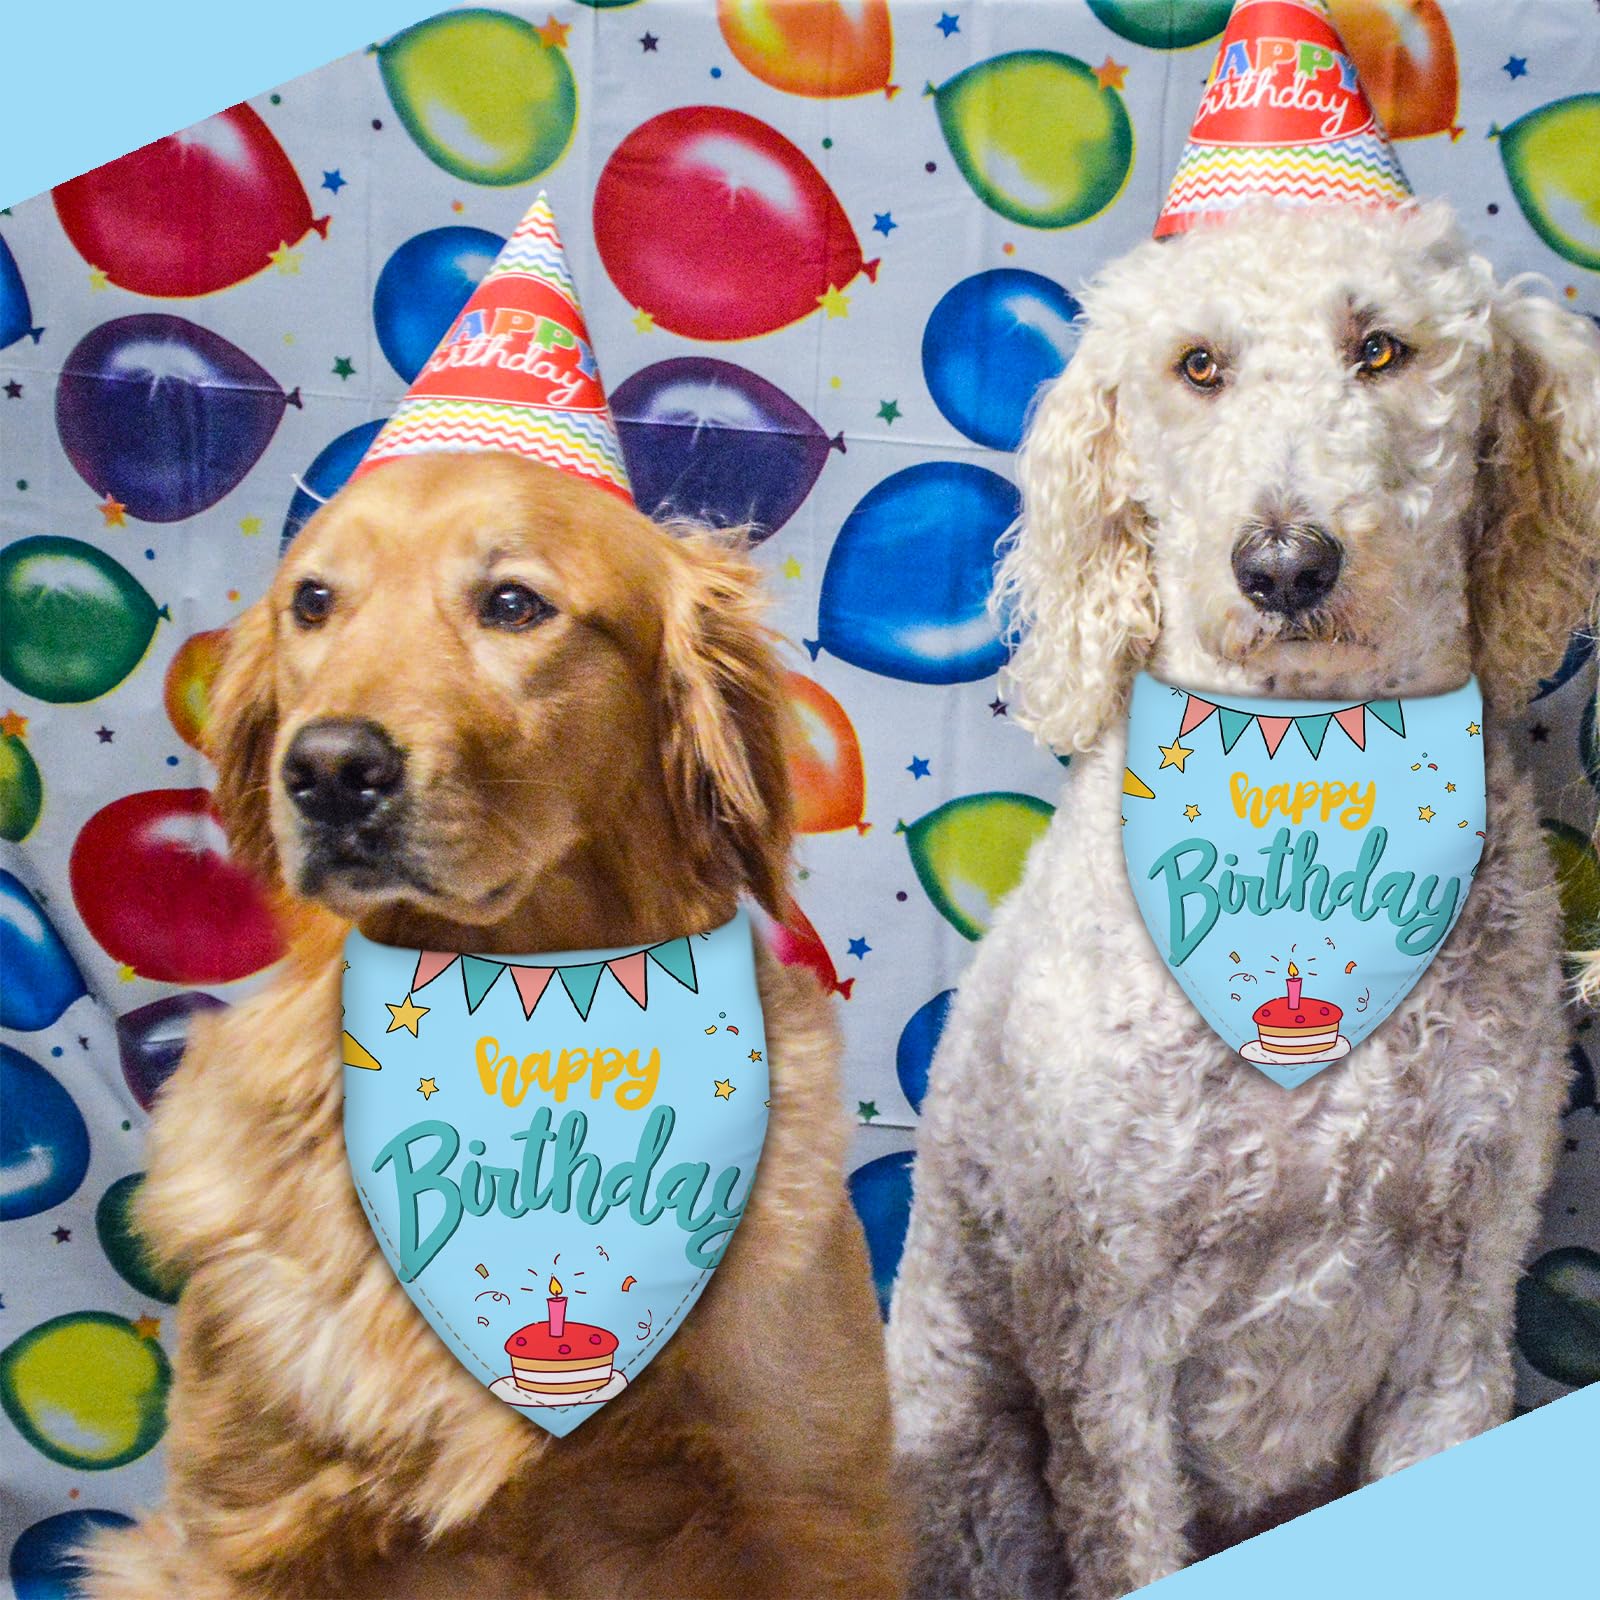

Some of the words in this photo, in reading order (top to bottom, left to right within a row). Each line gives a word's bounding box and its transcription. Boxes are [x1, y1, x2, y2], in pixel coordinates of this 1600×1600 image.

[1204, 37, 1359, 95] APPY
[416, 332, 584, 405] irthday
[1229, 771, 1376, 831] happy
[1148, 826, 1460, 967] Birthday
[475, 1036, 661, 1111] happy
[371, 1104, 757, 1284] Birthday
